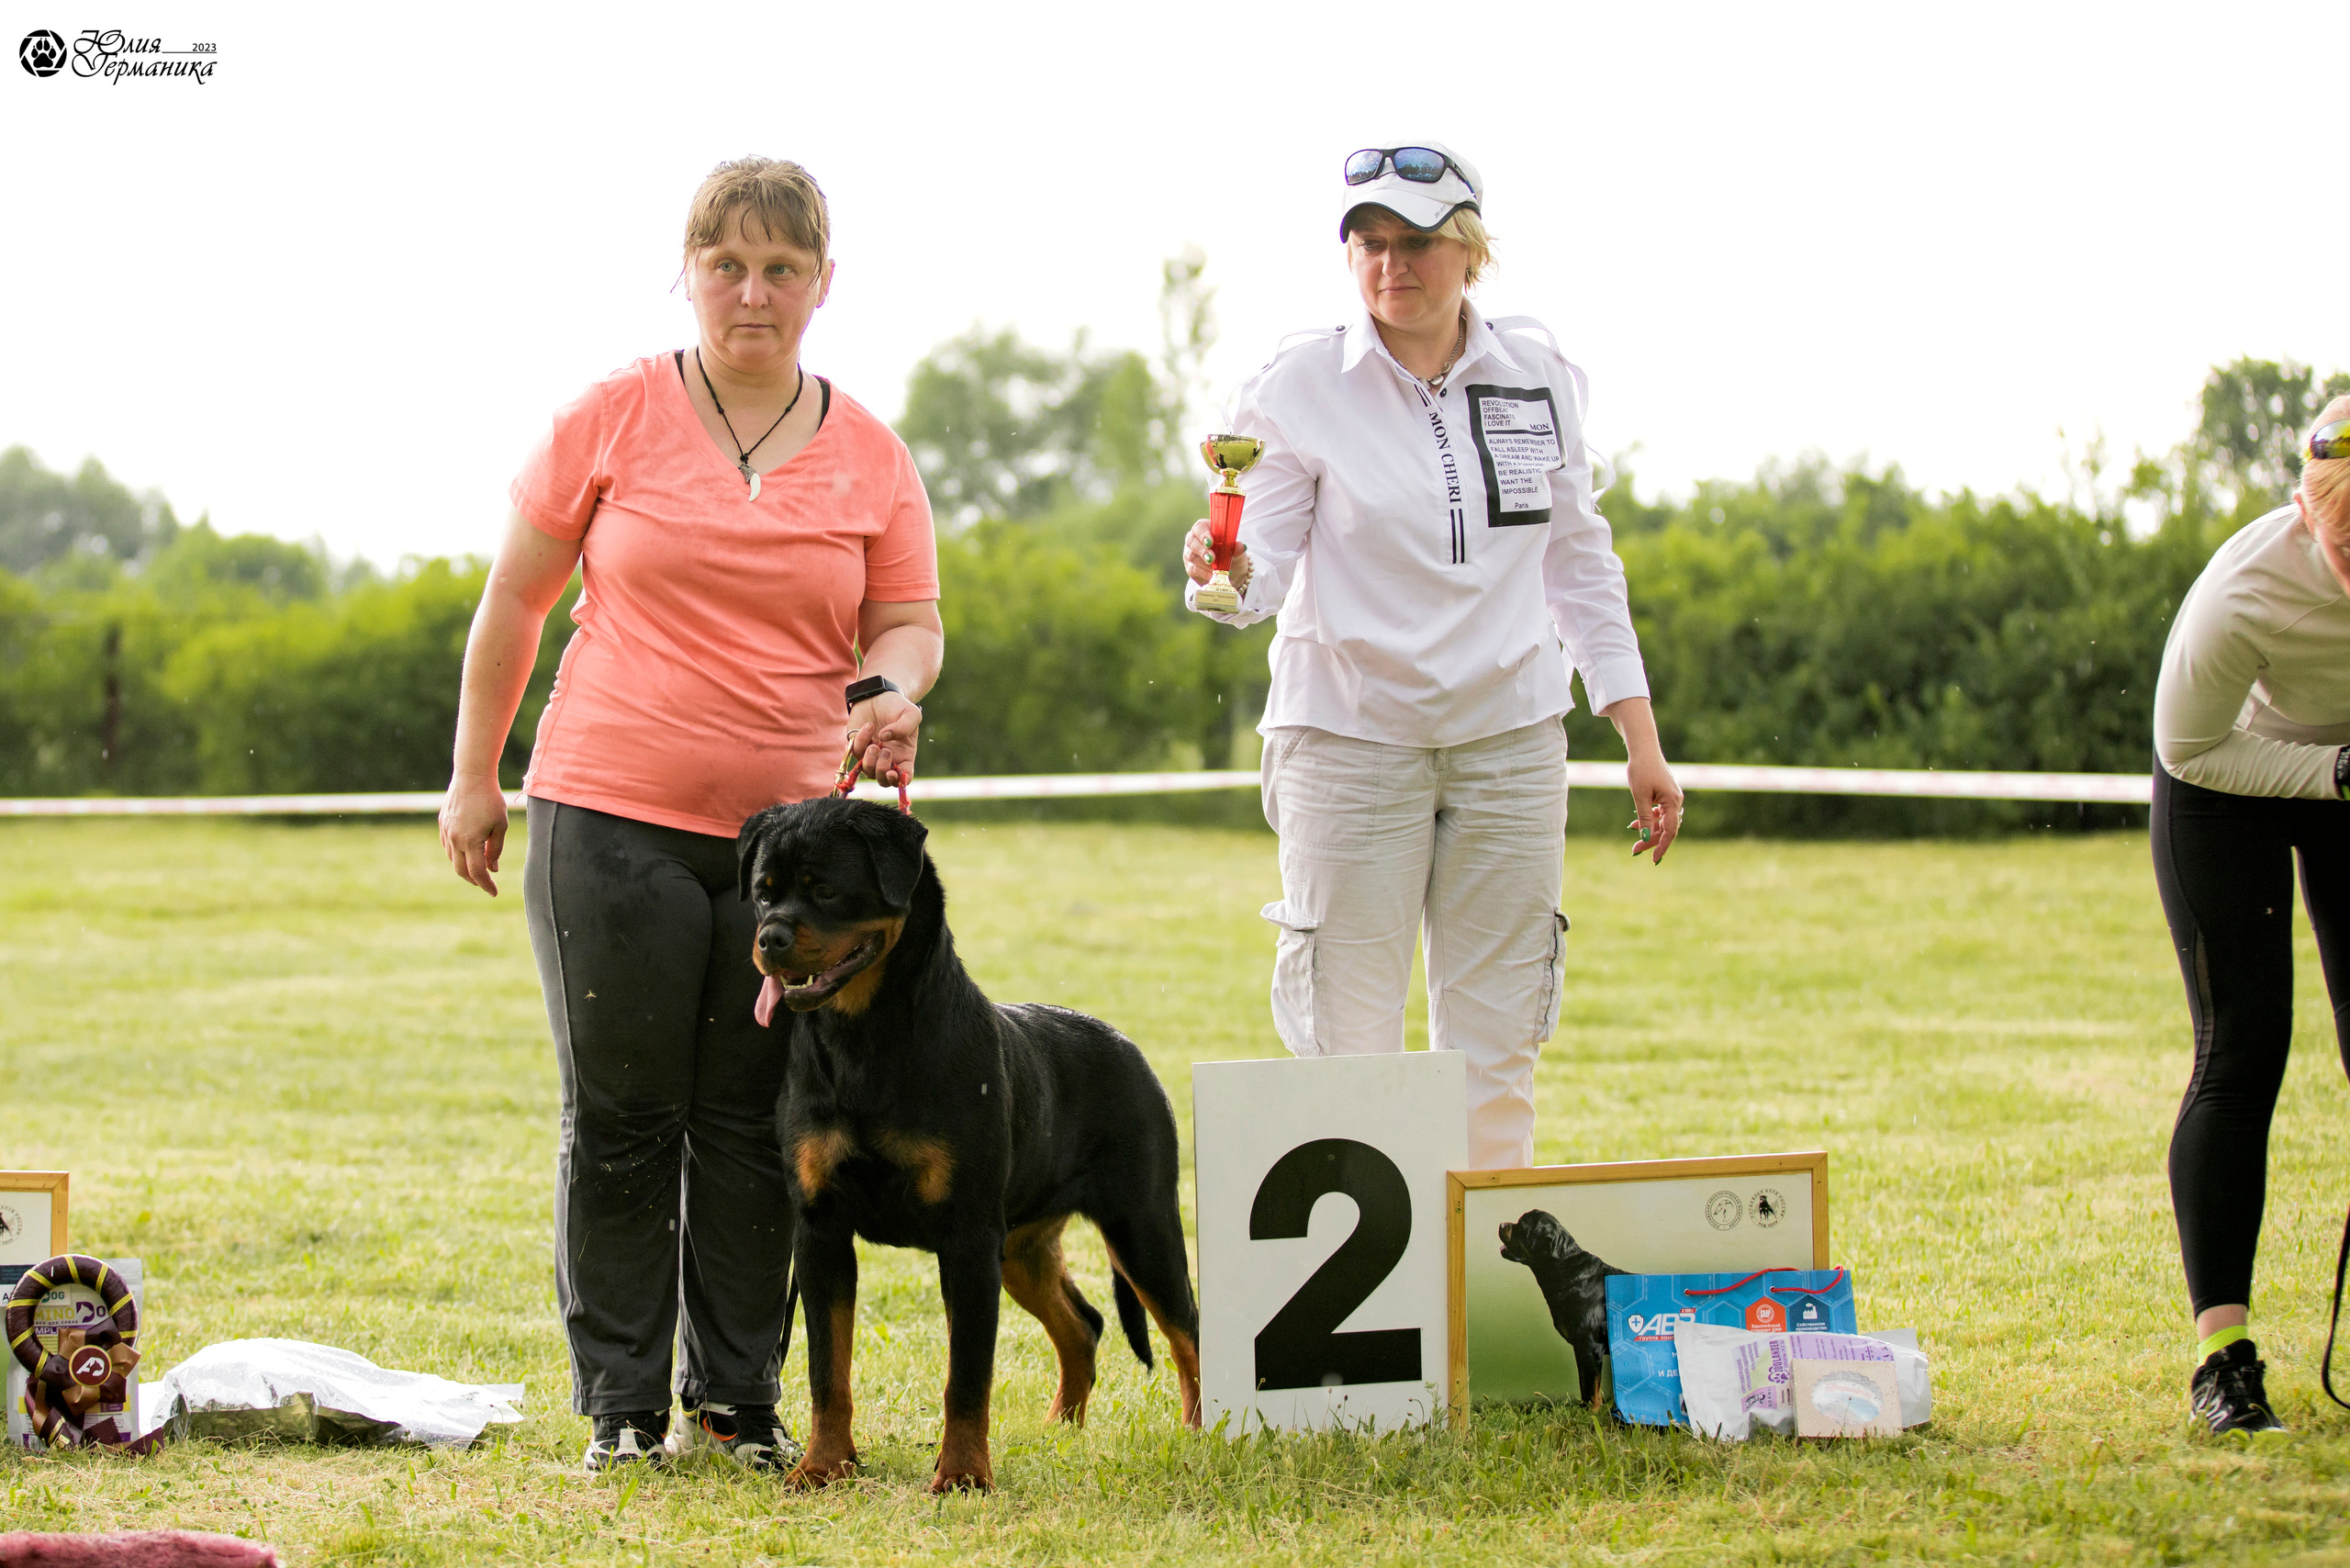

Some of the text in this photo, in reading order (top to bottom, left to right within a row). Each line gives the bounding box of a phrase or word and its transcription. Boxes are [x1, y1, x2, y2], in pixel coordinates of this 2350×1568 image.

[1482, 400, 1518, 409] REVOLUTION
[1514, 438, 1546, 446] REMEMBER
[1428, 411, 1462, 503] MON CHERI
[1502, 487, 1539, 495] IMPOSSIBLE
[1249, 1137, 1423, 1391] 2
[34, 1307, 75, 1321] MINO
[1769, 1339, 1784, 1372] ZOOLANDER
